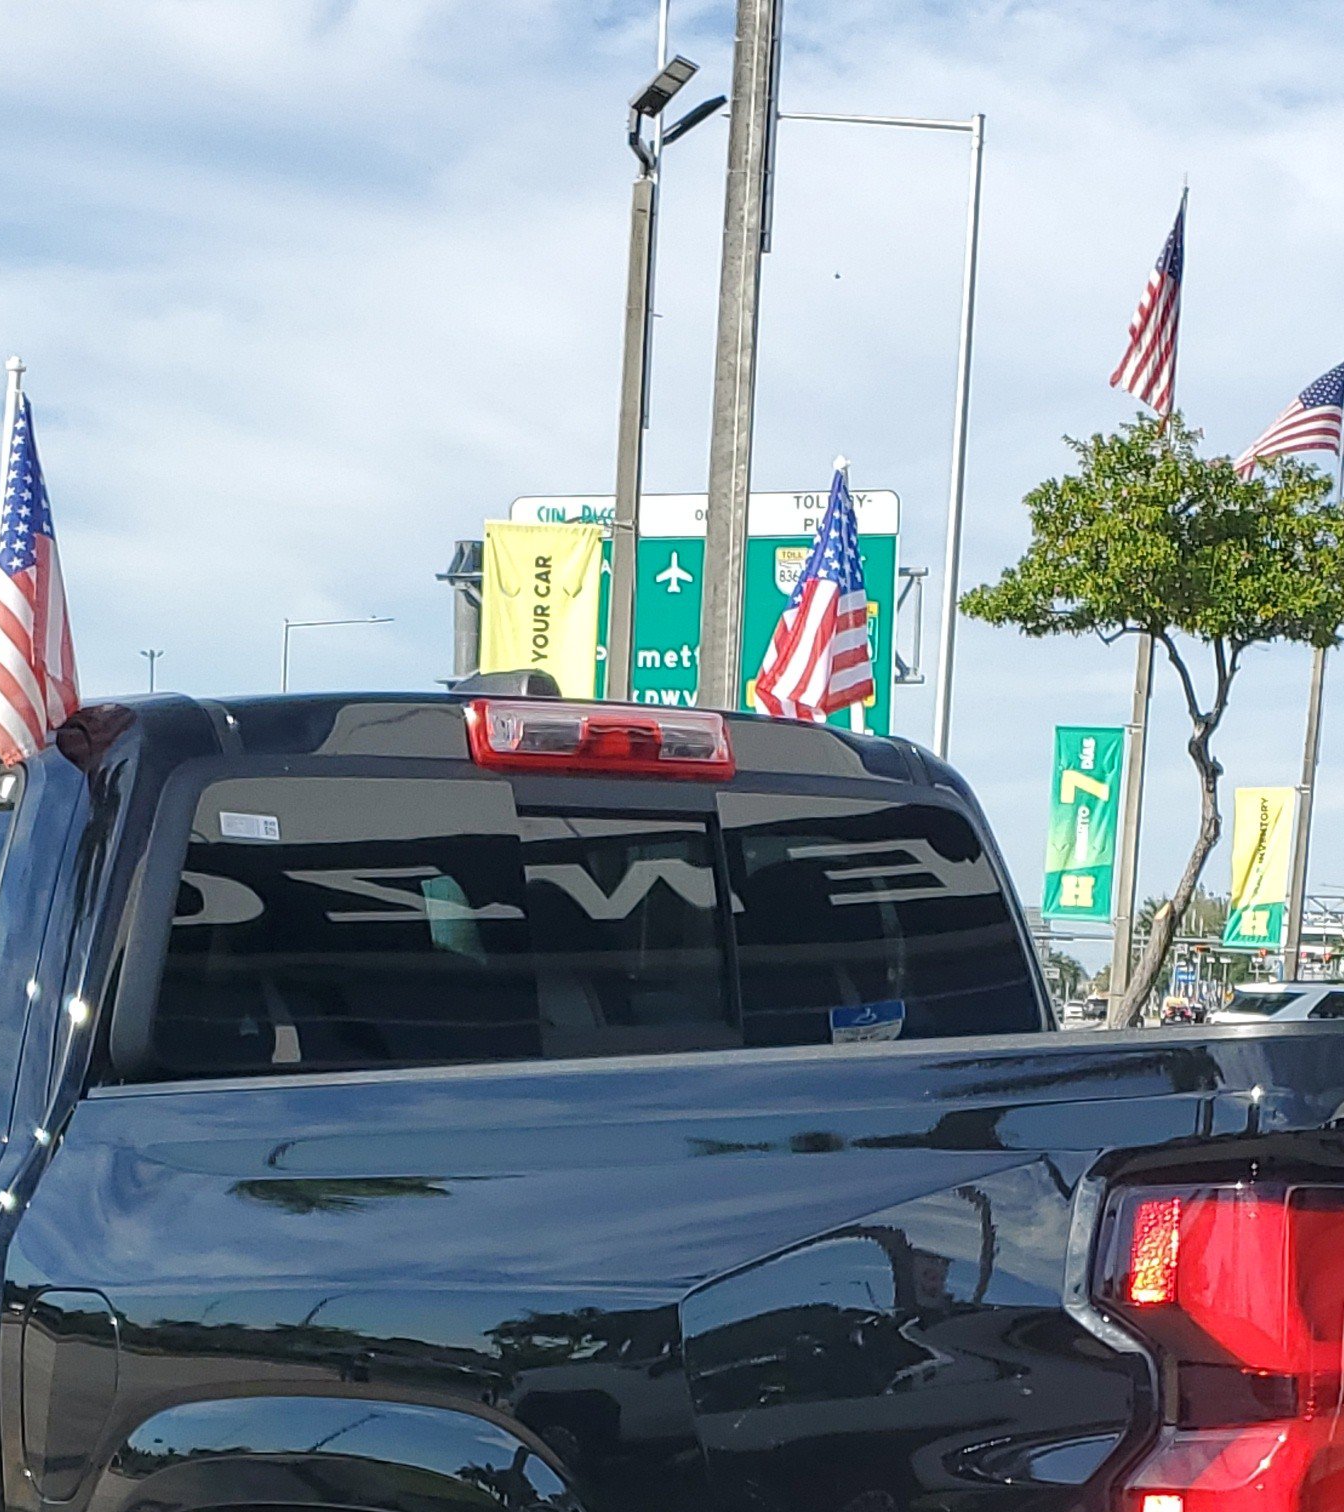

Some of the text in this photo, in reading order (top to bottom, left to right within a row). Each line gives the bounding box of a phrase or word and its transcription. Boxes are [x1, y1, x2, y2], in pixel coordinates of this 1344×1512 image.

[531, 555, 552, 663] YOUR CAR
[1060, 769, 1110, 804] 7
